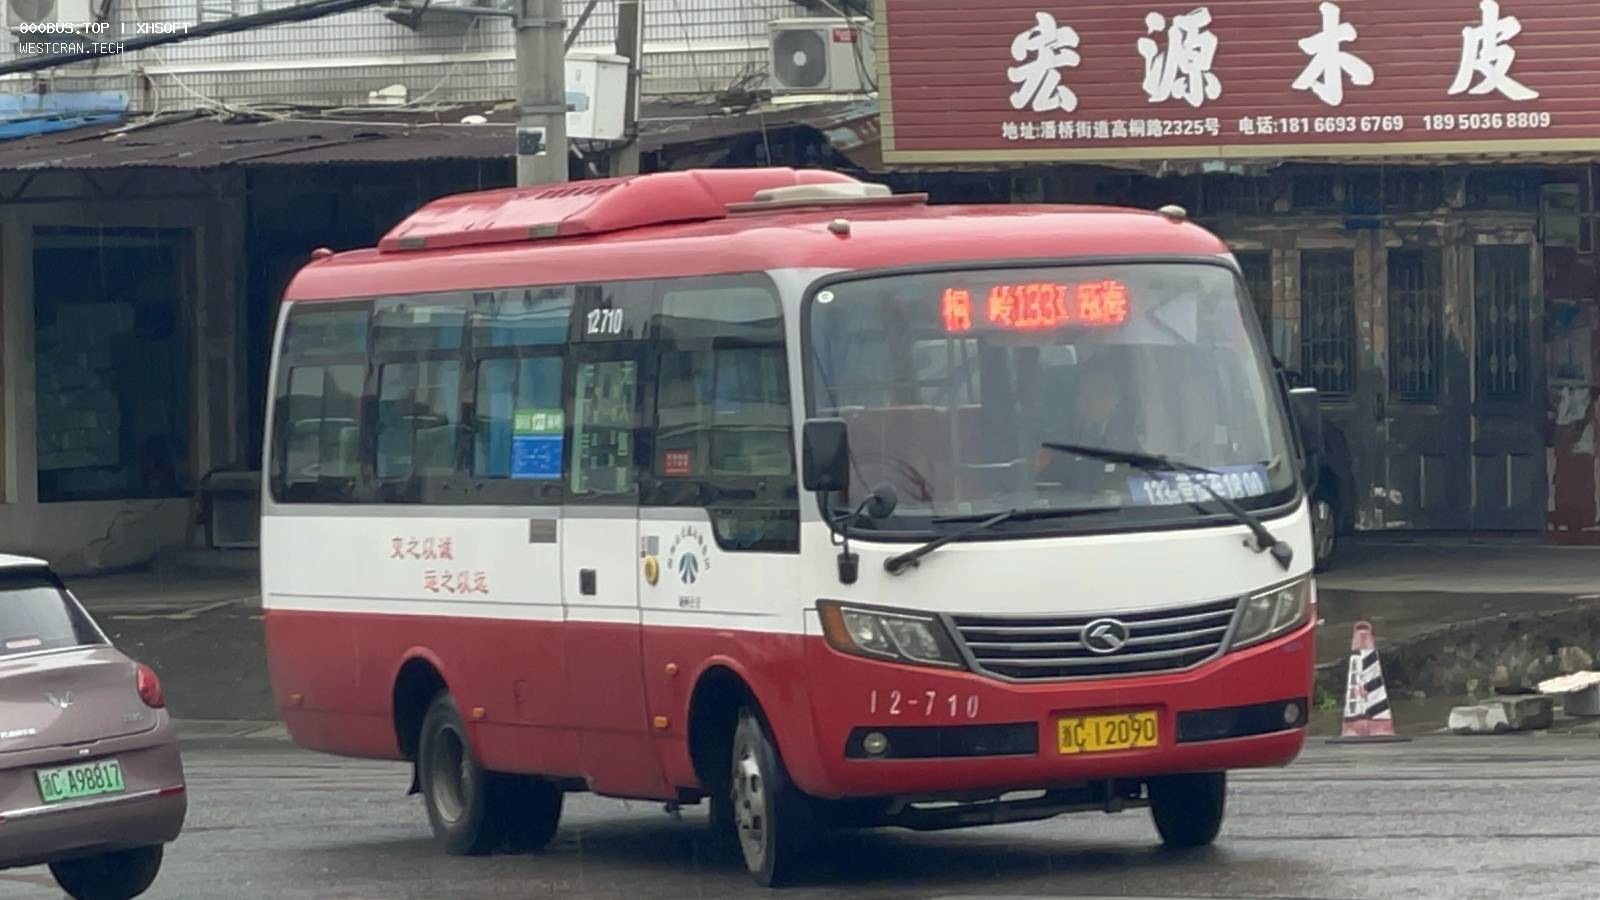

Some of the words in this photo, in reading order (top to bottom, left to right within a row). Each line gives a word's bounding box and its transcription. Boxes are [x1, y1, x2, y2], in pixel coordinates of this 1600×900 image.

[1007, 0, 1539, 112] 宏源木皮
[1313, 116, 1357, 133] 6693
[1361, 115, 1404, 132] 6769
[1423, 113, 1454, 131] 189
[1458, 112, 1503, 130] 5036
[1506, 111, 1551, 129] 8809
[587, 308, 623, 334] 12710
[870, 689, 980, 718] 12-710
